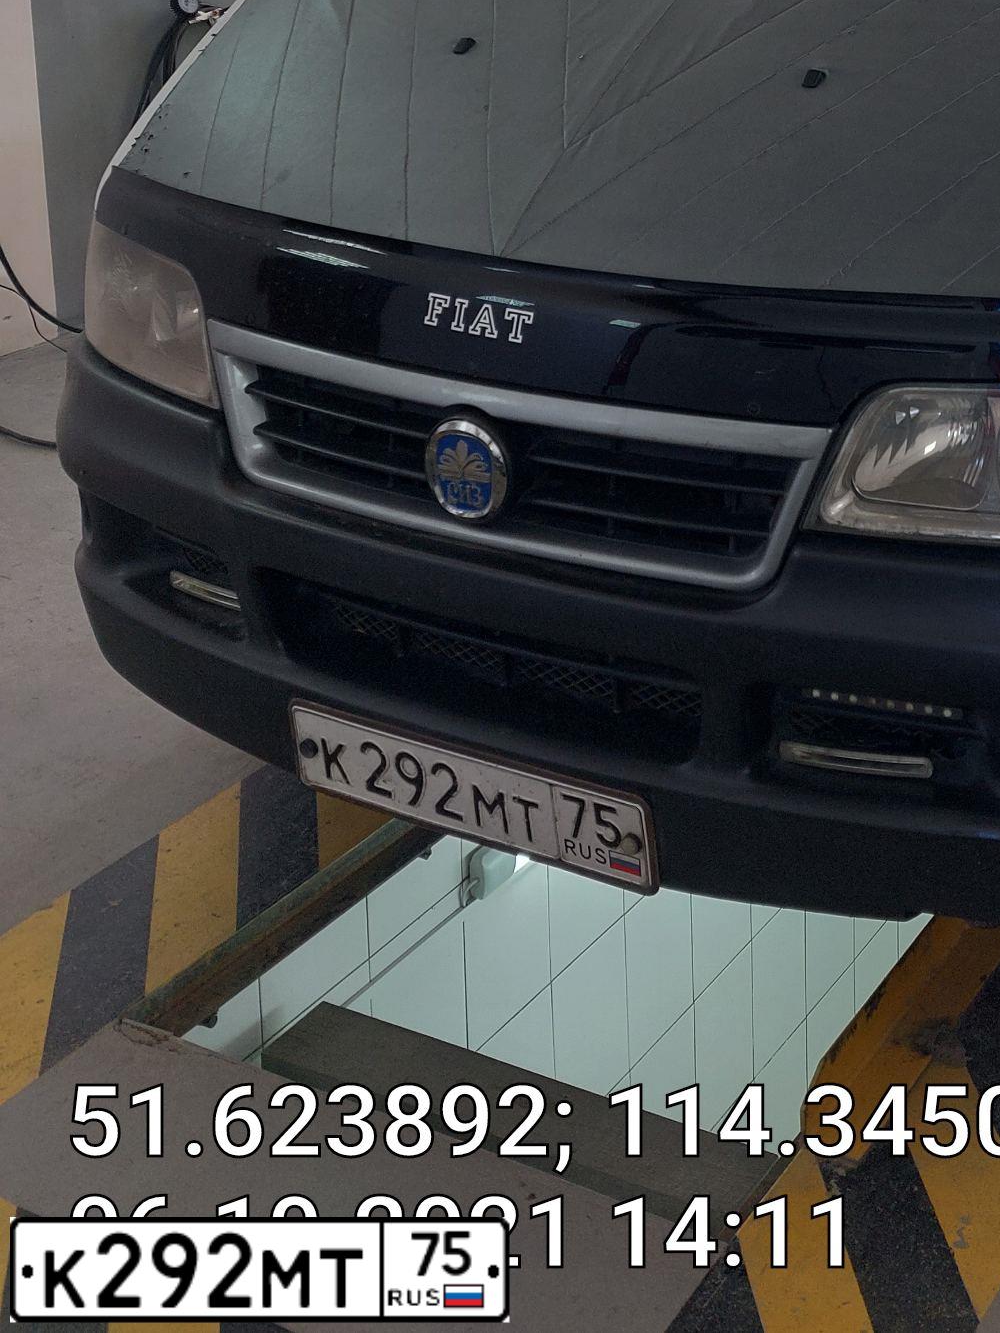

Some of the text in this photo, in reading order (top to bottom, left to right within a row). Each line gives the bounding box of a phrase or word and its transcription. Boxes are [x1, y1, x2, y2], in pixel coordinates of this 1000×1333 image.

[424, 292, 534, 344] FIAT
[562, 793, 623, 849] 75
[563, 838, 608, 866] RUS
